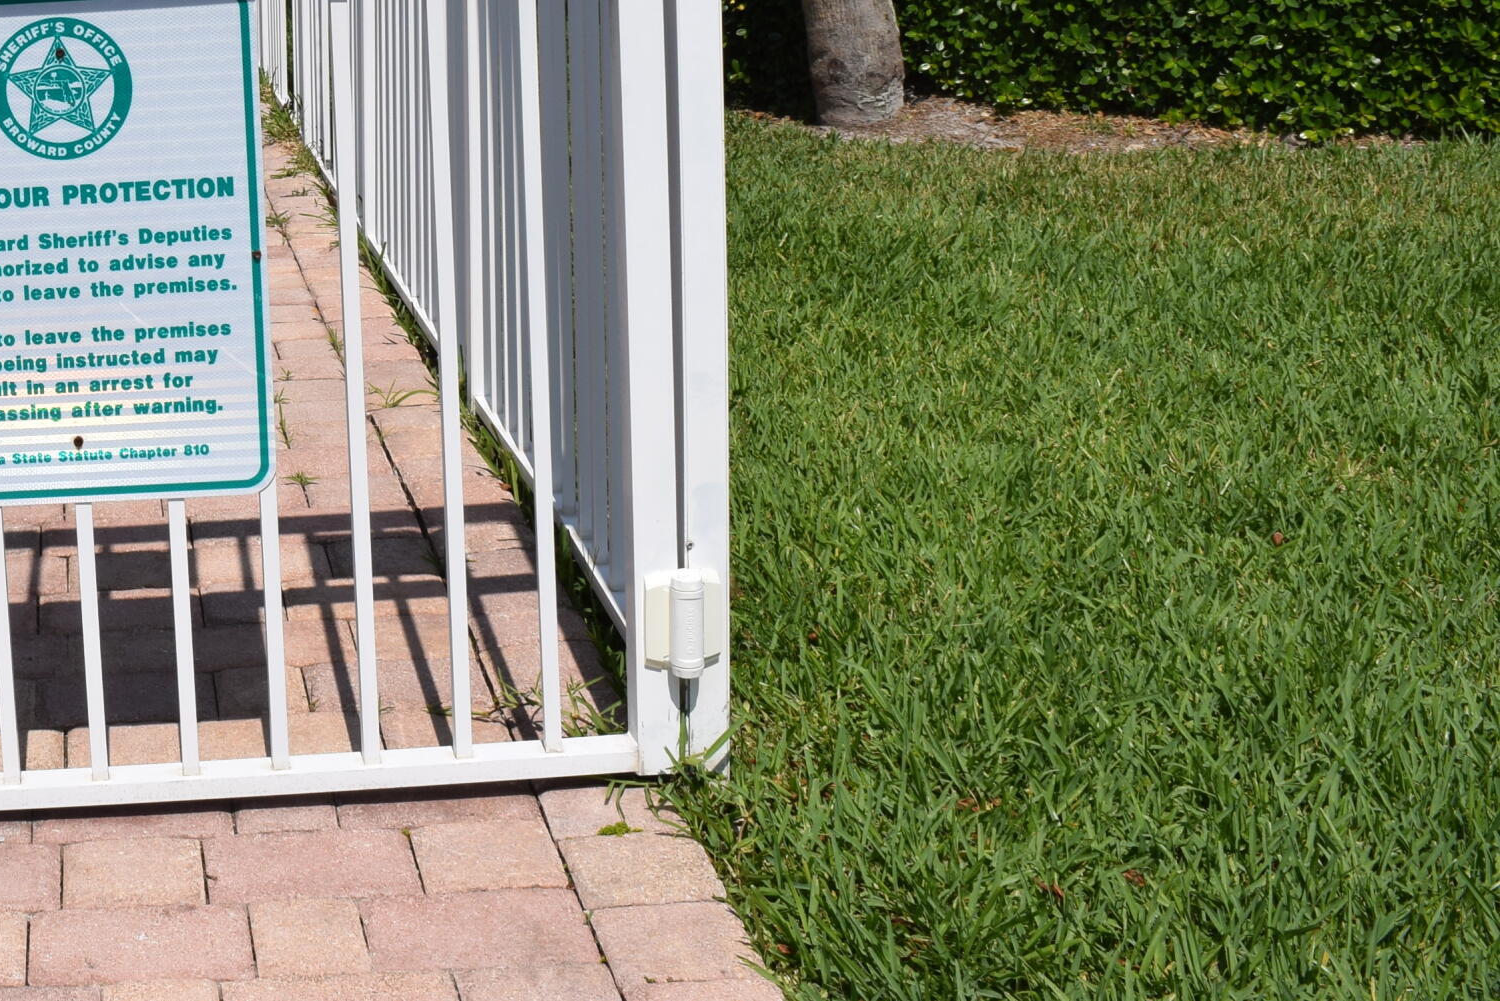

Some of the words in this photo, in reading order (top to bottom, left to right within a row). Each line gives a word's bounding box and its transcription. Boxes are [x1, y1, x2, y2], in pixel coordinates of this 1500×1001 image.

[73, 24, 123, 66] OFFICE
[2, 117, 67, 157] BROWARD
[74, 111, 120, 154] COUNTY
[62, 176, 234, 205] PROTECTION
[39, 230, 129, 249] Sheriff's
[139, 225, 232, 246] Deputies
[78, 258, 99, 273] to
[109, 253, 178, 271] advise
[188, 254, 225, 269] any
[24, 285, 80, 300] leave
[90, 281, 124, 297] the
[134, 277, 237, 298] premises.
[25, 330, 81, 345] leave
[91, 326, 125, 342] the
[135, 322, 231, 343] premises
[57, 348, 165, 368] instructed
[175, 350, 218, 365] may
[27, 380, 44, 394] in
[56, 381, 79, 393] an
[90, 375, 153, 392] arrest
[163, 373, 193, 388] for
[72, 401, 122, 417] after
[134, 397, 223, 414] warning.
[12, 453, 52, 464] State
[58, 450, 112, 462] Statute
[119, 448, 177, 460] Chapter
[184, 444, 209, 456] 810
